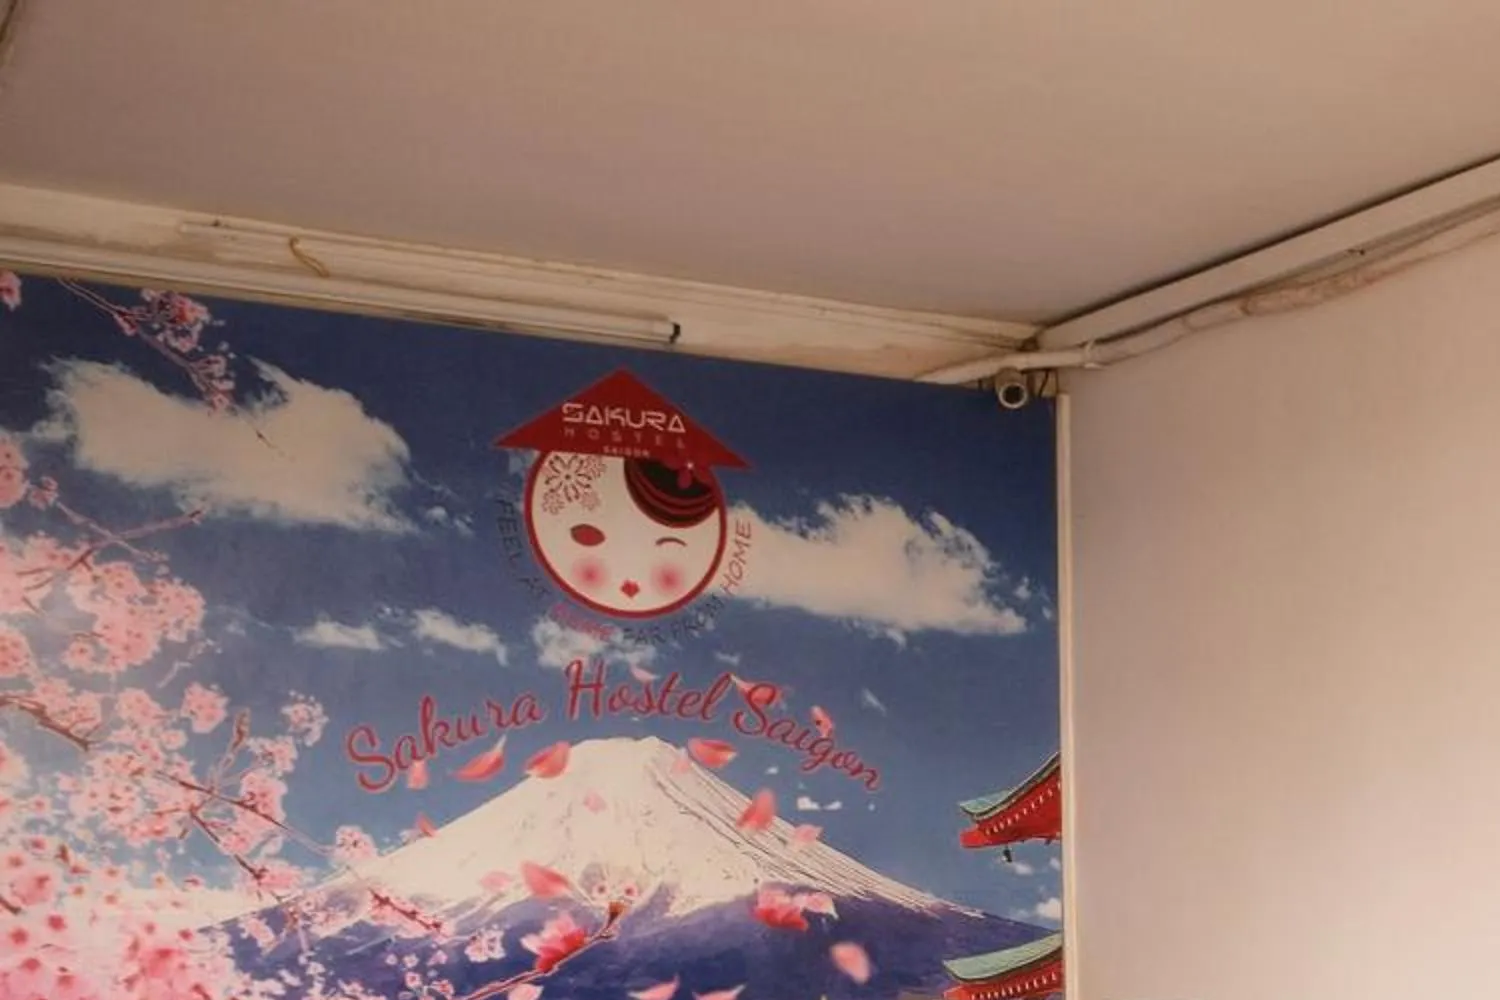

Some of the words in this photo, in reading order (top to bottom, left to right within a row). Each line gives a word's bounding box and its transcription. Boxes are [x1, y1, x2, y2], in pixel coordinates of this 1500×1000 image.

[561, 402, 687, 434] SAKURA
[563, 427, 686, 450] HOSTEL
[719, 520, 753, 597] HOME
[346, 691, 548, 794] Sakura
[563, 658, 733, 721] Hostel
[731, 681, 882, 792] Saigon
